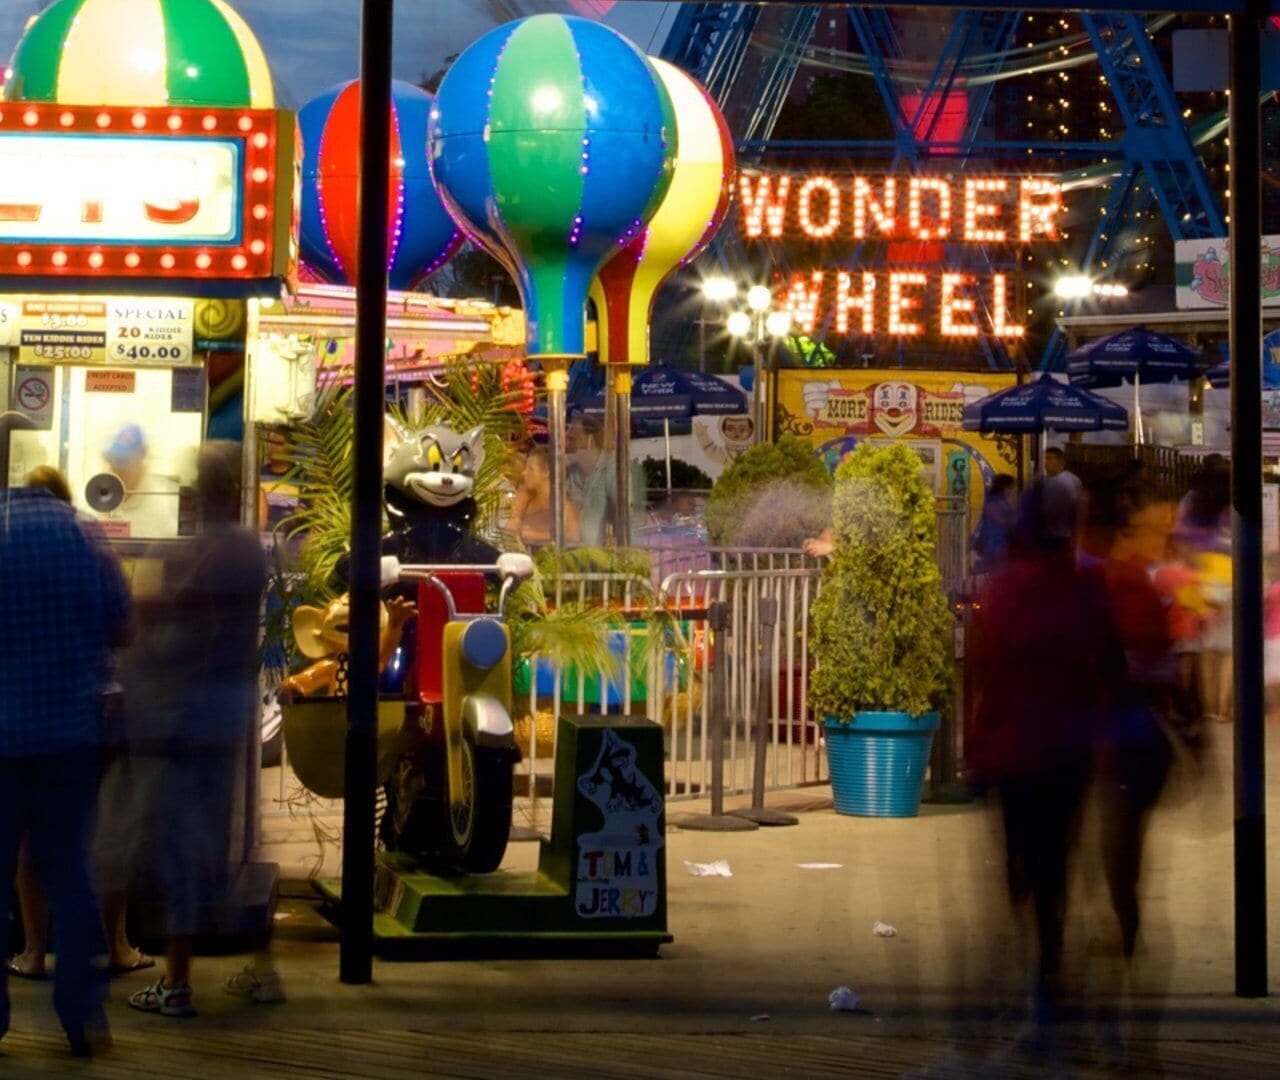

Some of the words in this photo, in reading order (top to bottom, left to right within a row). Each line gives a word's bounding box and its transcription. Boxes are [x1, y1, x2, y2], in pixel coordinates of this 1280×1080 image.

[738, 174, 1063, 242] WONDER
[775, 272, 1026, 336] WHEEL
[114, 308, 187, 320] SPECIAL
[23, 334, 41, 342] TEN
[43, 334, 75, 343] KIDDIE
[76, 335, 104, 343] RIDES
[118, 326, 141, 338] 20
[35, 344, 92, 359] $25.00
[116, 343, 181, 359] $40.00
[827, 399, 866, 419] MORE
[925, 401, 964, 422] RIDES
[583, 850, 632, 877] TOM
